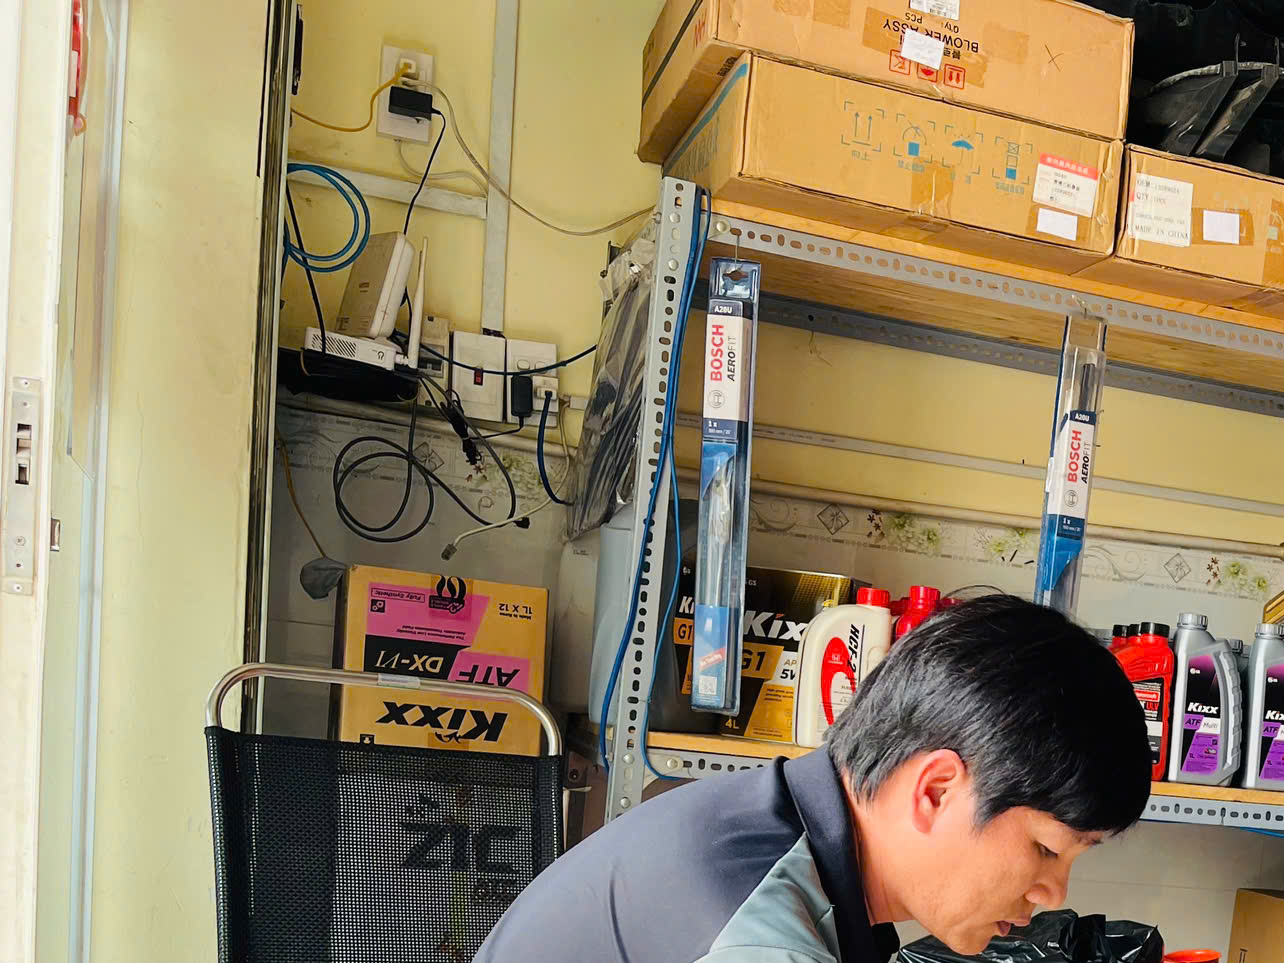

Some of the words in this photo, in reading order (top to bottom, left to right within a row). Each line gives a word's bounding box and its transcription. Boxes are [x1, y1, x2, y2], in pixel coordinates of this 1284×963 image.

[905, 13, 923, 24] PCS
[710, 324, 724, 382] BOSCH
[727, 336, 737, 382] AEROFIT
[1067, 429, 1082, 483] BOSCH
[1081, 442, 1091, 484] AEROFIT
[499, 602, 510, 612] 12
[512, 604, 520, 613] X
[522, 605, 533, 615] 1L
[679, 596, 694, 614] Ki
[743, 610, 811, 641] Kix
[847, 623, 860, 673] HCF-2
[375, 650, 444, 673] DX-VI
[456, 663, 520, 687] ATF
[1187, 702, 1219, 715] Kixx
[375, 700, 508, 742] Kixx
[725, 718, 740, 729] 4L
[1185, 718, 1201, 727] ATF
[1263, 726, 1279, 735] ATF
